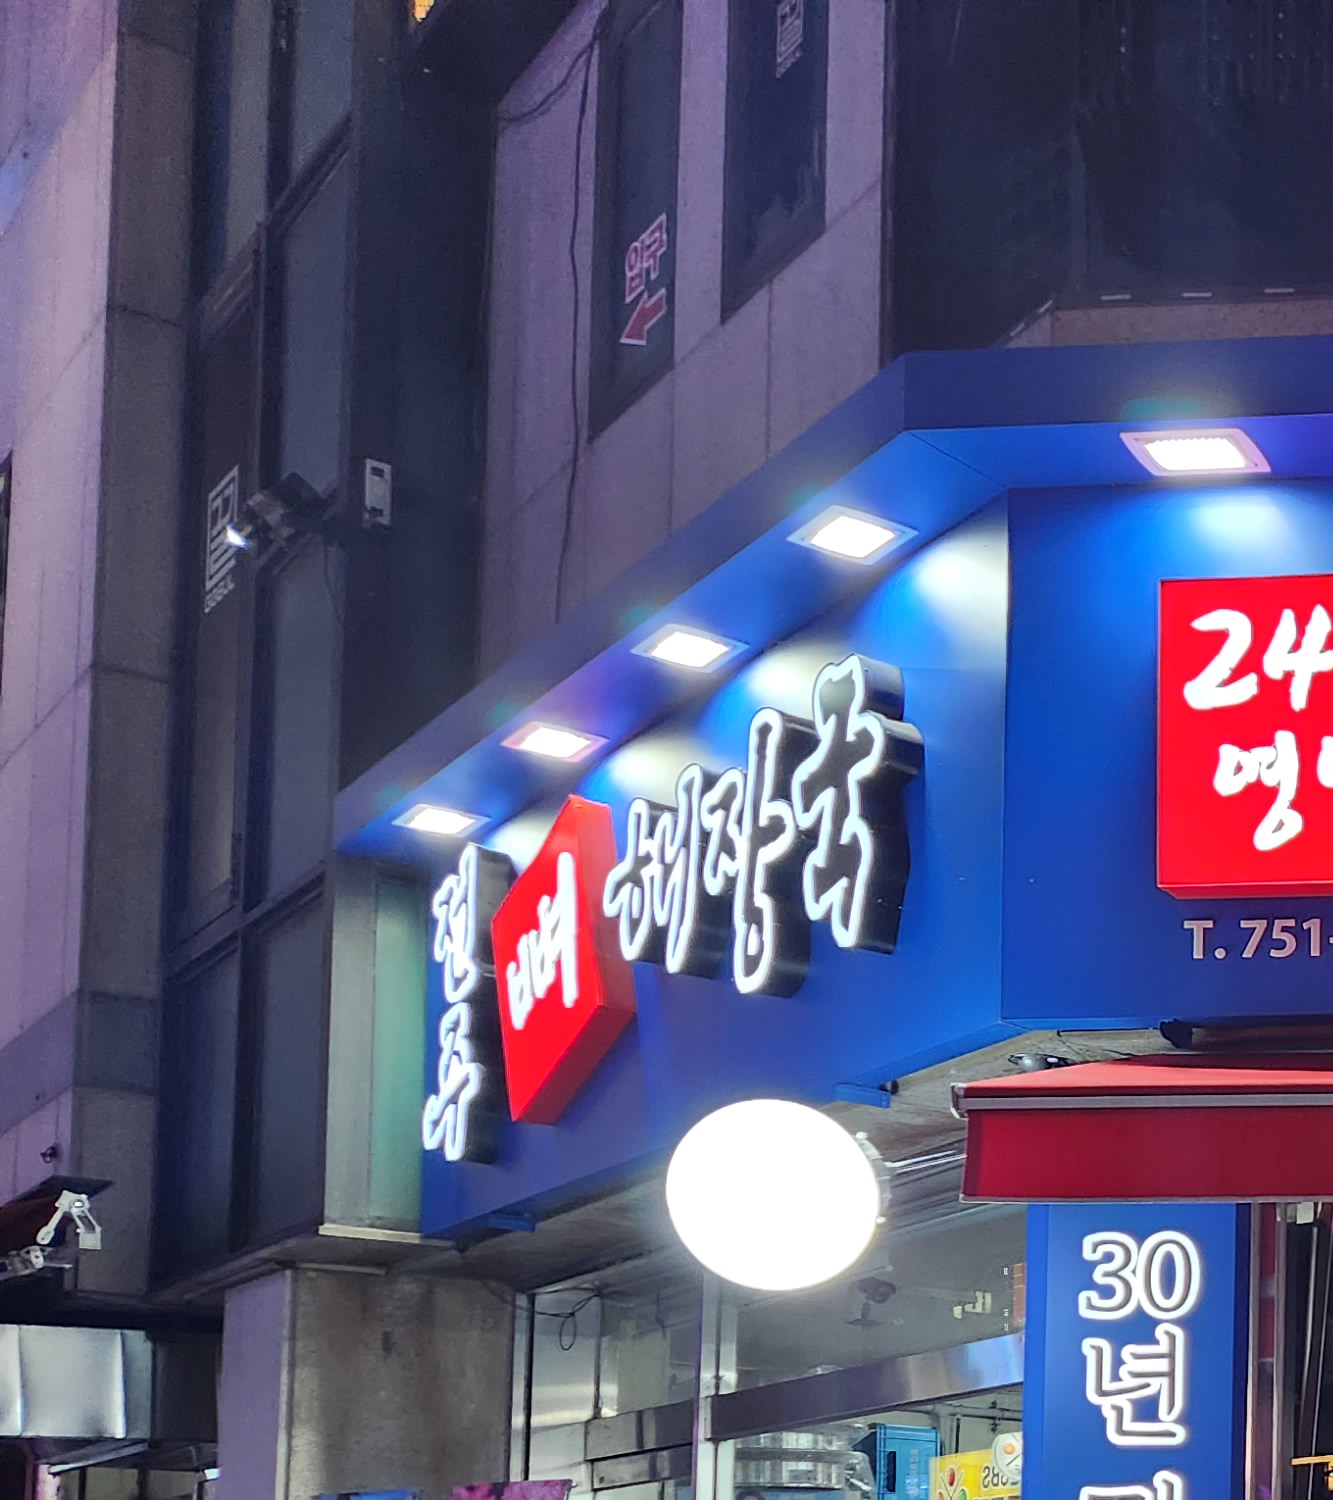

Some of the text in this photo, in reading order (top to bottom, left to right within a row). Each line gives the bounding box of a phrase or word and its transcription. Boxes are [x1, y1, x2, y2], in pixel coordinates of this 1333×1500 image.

[625, 213, 667, 304] 입구
[423, 653, 885, 1162] 전주 뼈 해장국
[1078, 1231, 1201, 1446] 30년
